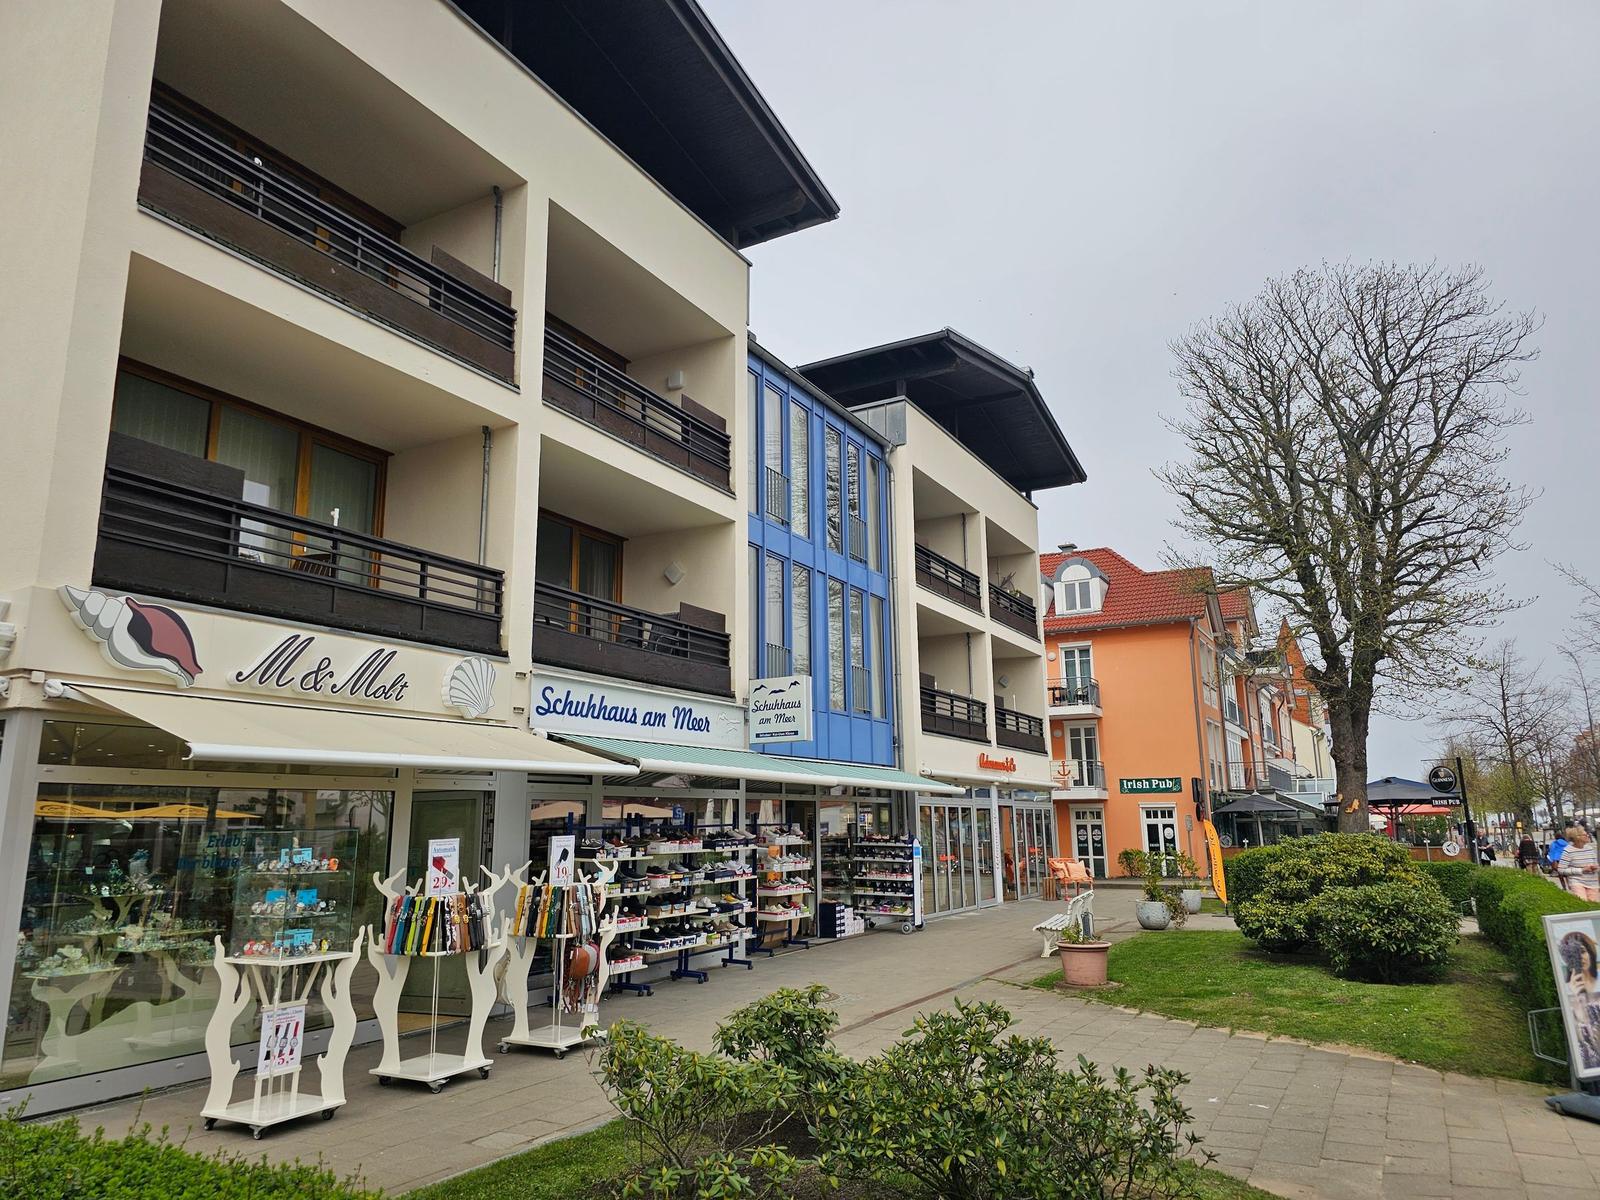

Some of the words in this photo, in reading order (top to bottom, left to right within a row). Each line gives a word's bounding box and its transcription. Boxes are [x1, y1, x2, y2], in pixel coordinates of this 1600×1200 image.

[235, 633, 316, 688] M
[299, 656, 335, 693] &
[330, 647, 409, 702] Molt
[535, 685, 638, 725] Schuhhaus
[640, 709, 667, 728] am
[672, 705, 711, 733] Meer
[751, 698, 802, 713] Schuhhaus
[758, 717, 772, 725] am
[773, 712, 796, 724] Meer
[1122, 779, 1150, 789] Irish
[1151, 779, 1173, 789] Pub
[1448, 798, 1461, 806] PUB
